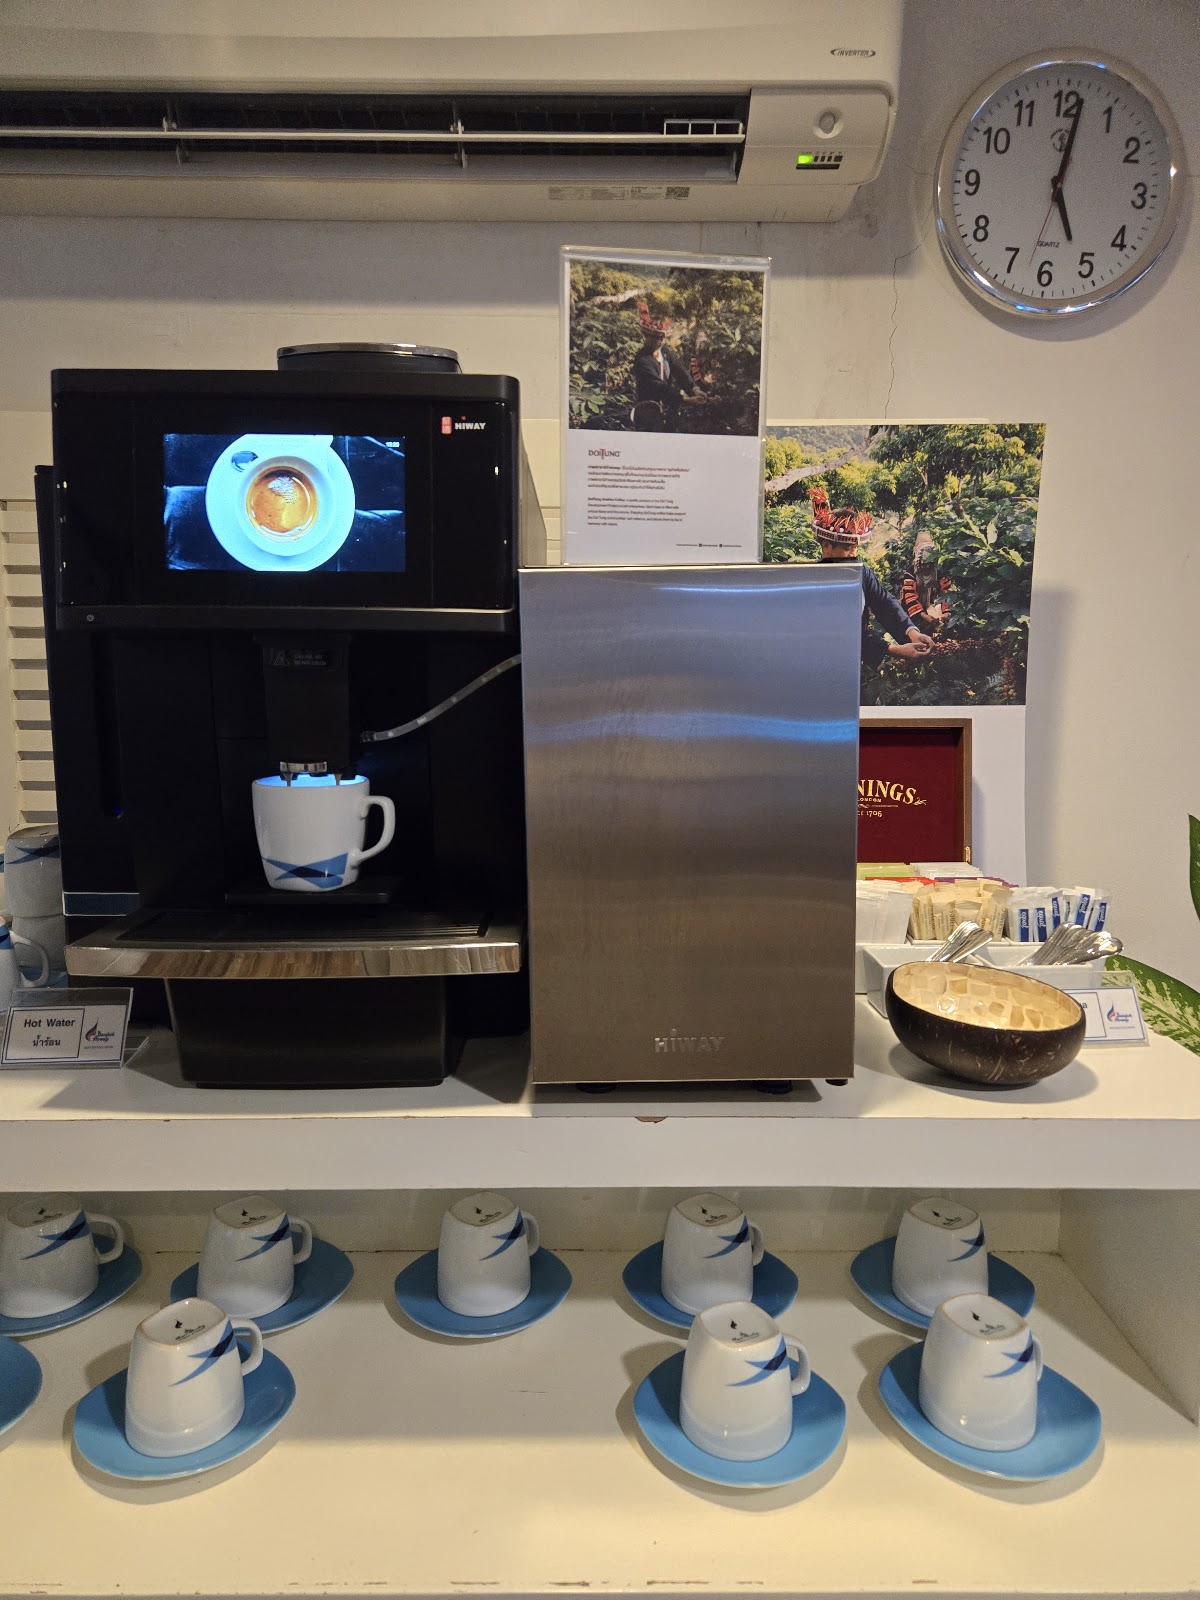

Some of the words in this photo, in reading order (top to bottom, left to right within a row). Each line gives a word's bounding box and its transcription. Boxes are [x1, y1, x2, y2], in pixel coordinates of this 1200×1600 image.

[1014, 100, 1035, 127] 11
[1053, 90, 1080, 118] 12
[1102, 106, 1113, 133] 1
[983, 127, 1011, 154] 10
[1122, 137, 1141, 164] 2
[964, 169, 981, 196] 9
[1130, 182, 1147, 209] 3
[972, 214, 990, 242] 8
[1110, 224, 1127, 251] 4
[1005, 247, 1020, 273] 7
[1078, 252, 1095, 278] 5
[1036, 260, 1053, 287] 6
[1052, 900, 1060, 917] equal
[1079, 896, 1088, 914] equal
[1097, 905, 1106, 923] equal
[1019, 911, 1029, 929] equal
[1036, 910, 1046, 928] equal
[23, 1018, 42, 1028] Hot
[46, 1018, 76, 1028] Water
[32, 1035, 61, 1047] น้ำร้อน
[654, 1028, 725, 1053] HIWAY
